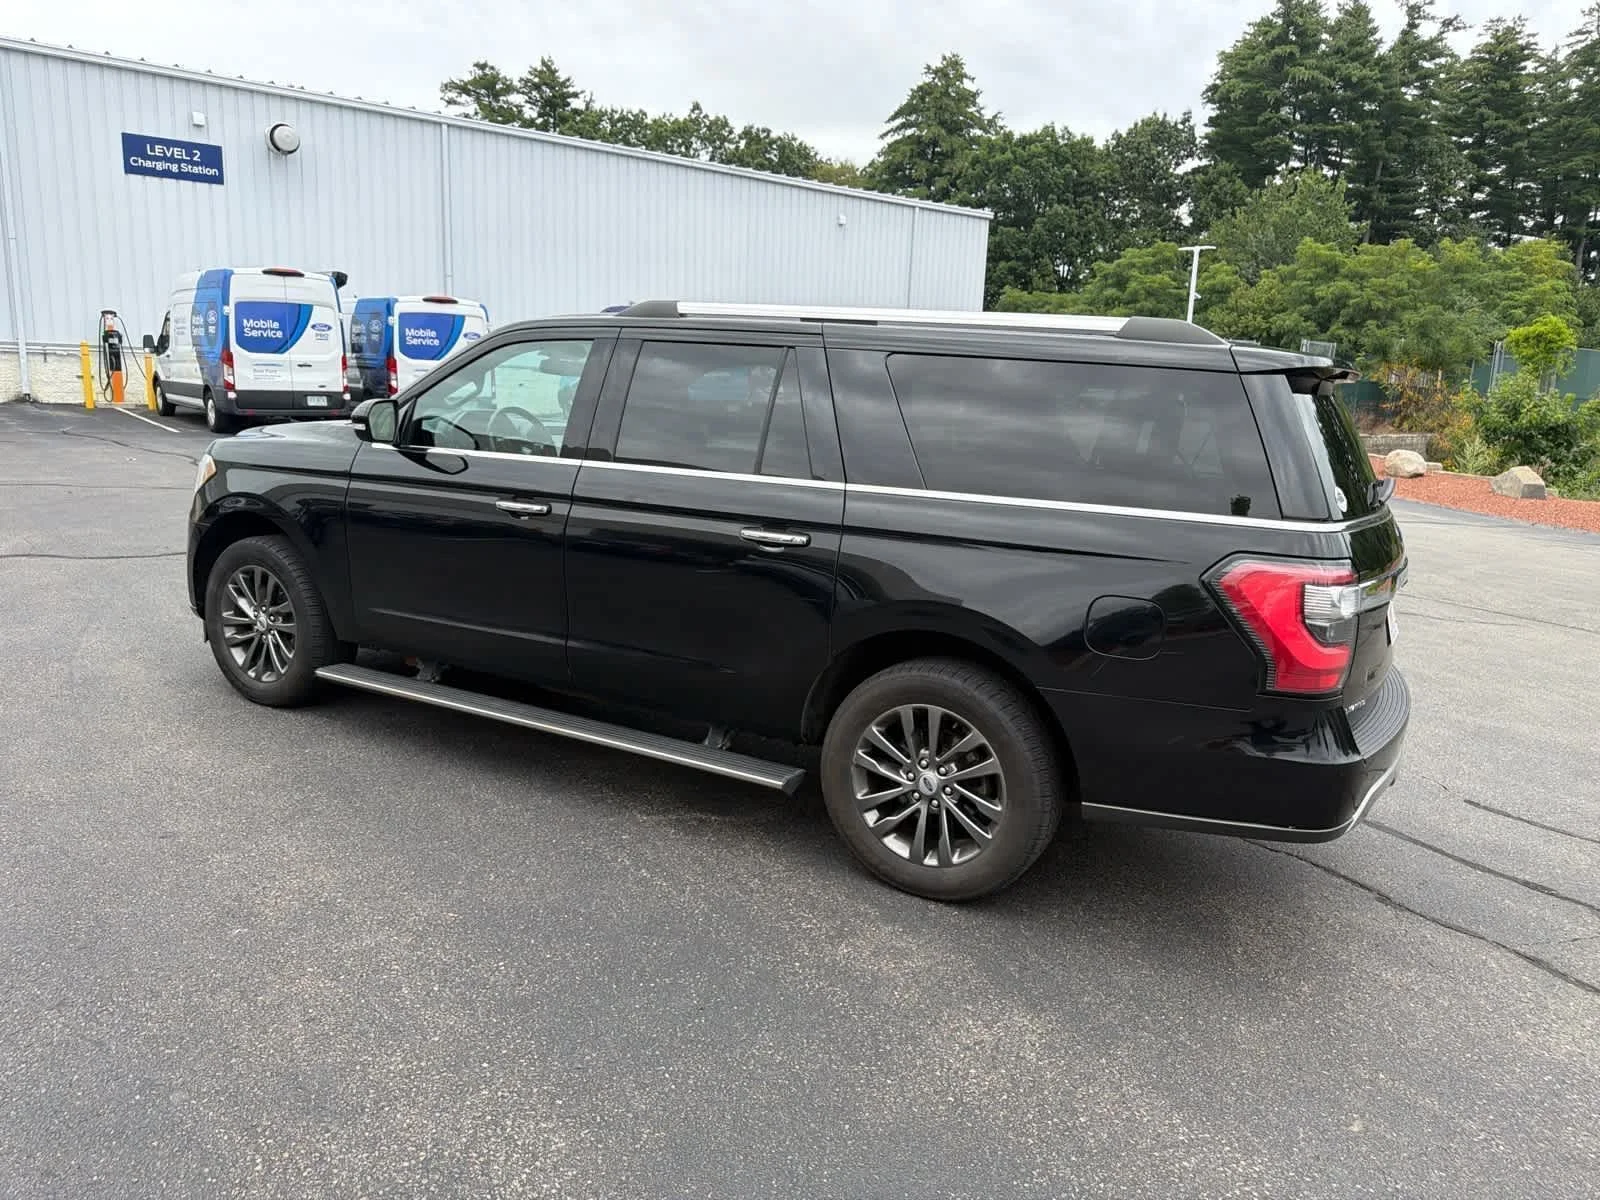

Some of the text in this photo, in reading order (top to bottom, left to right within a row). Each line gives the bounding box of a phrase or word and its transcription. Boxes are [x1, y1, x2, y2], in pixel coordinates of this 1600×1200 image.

[146, 144, 201, 161] LEVEL 2
[130, 157, 219, 176] Charging Station
[243, 319, 280, 329] Mobile
[243, 328, 283, 338] Service
[405, 328, 437, 337] Mobile
[405, 337, 440, 346] Service
